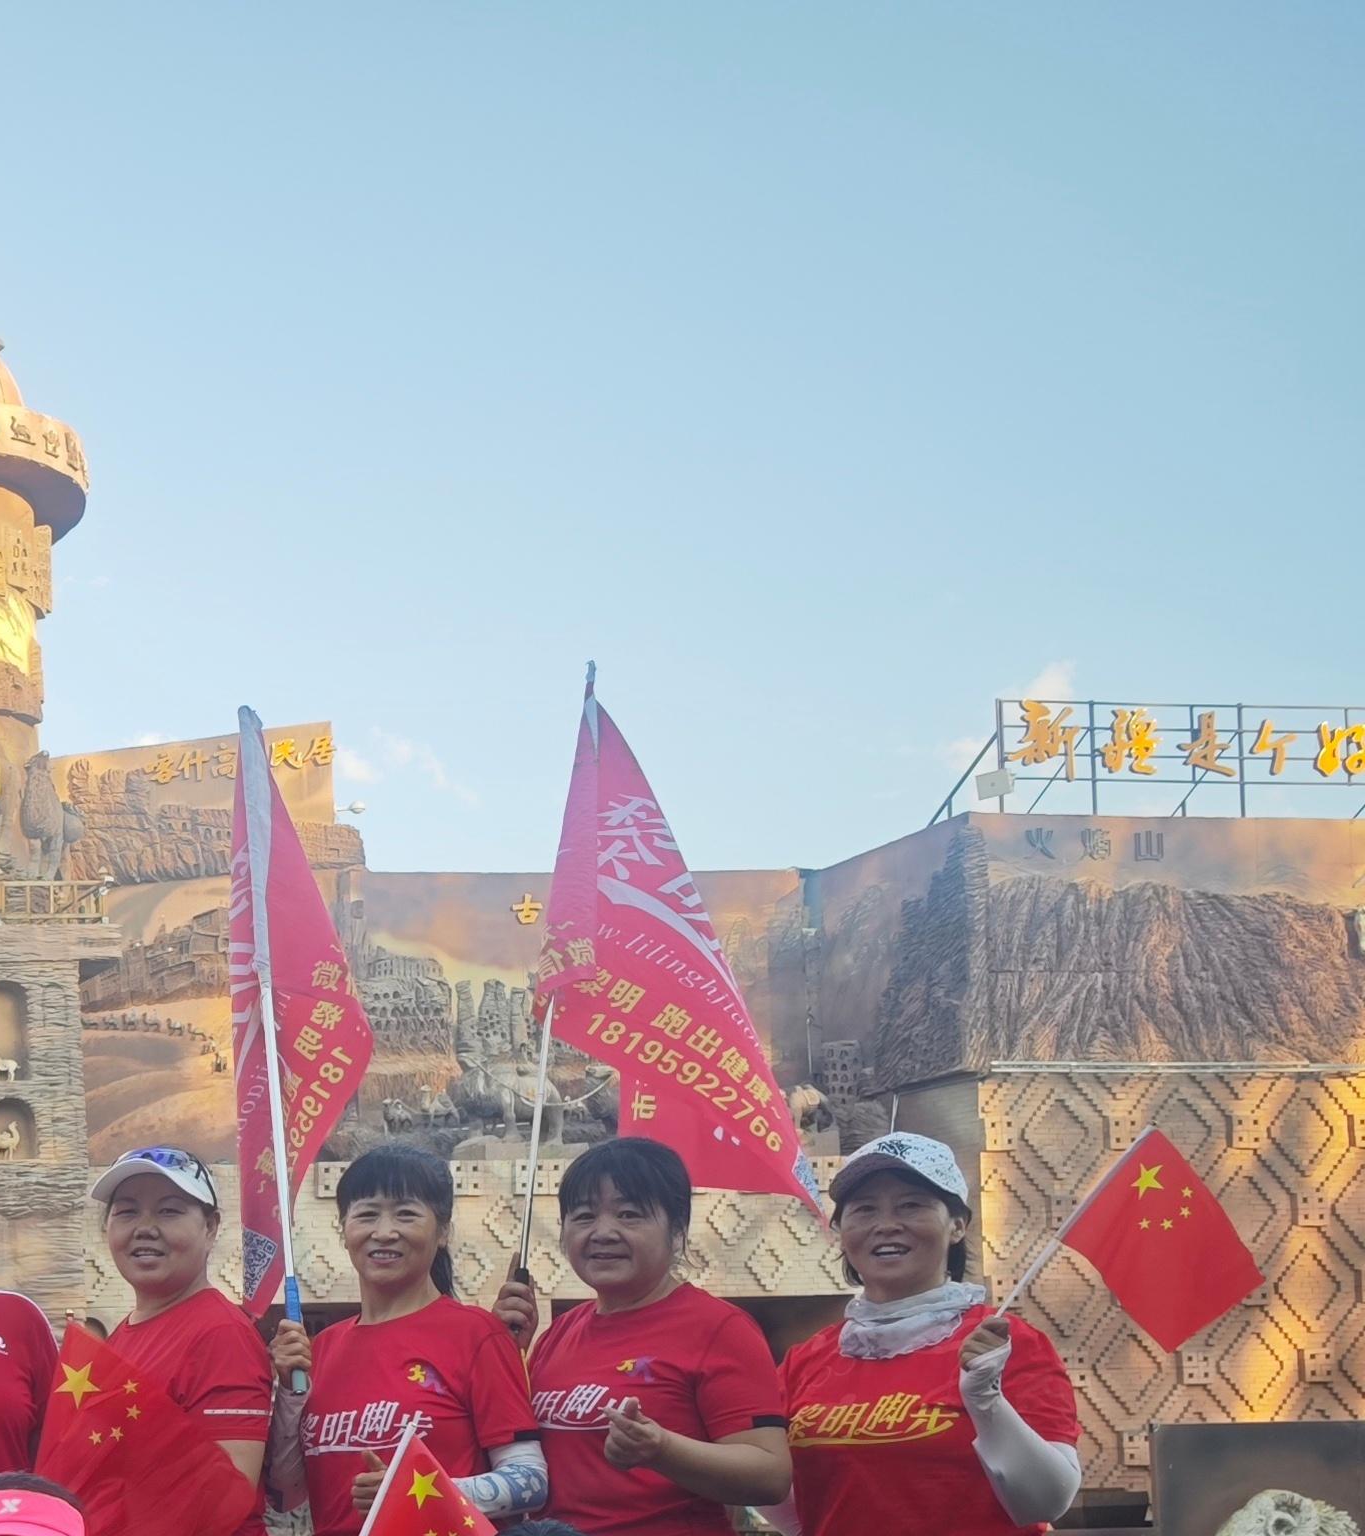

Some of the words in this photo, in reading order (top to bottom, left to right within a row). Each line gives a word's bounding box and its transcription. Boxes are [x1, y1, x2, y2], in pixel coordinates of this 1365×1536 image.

[144, 736, 337, 785] 喀什高民居
[1005, 699, 1365, 782] 新疆是个好
[1025, 826, 1166, 862] 火焰山
[586, 1012, 784, 1153] 18195922766
